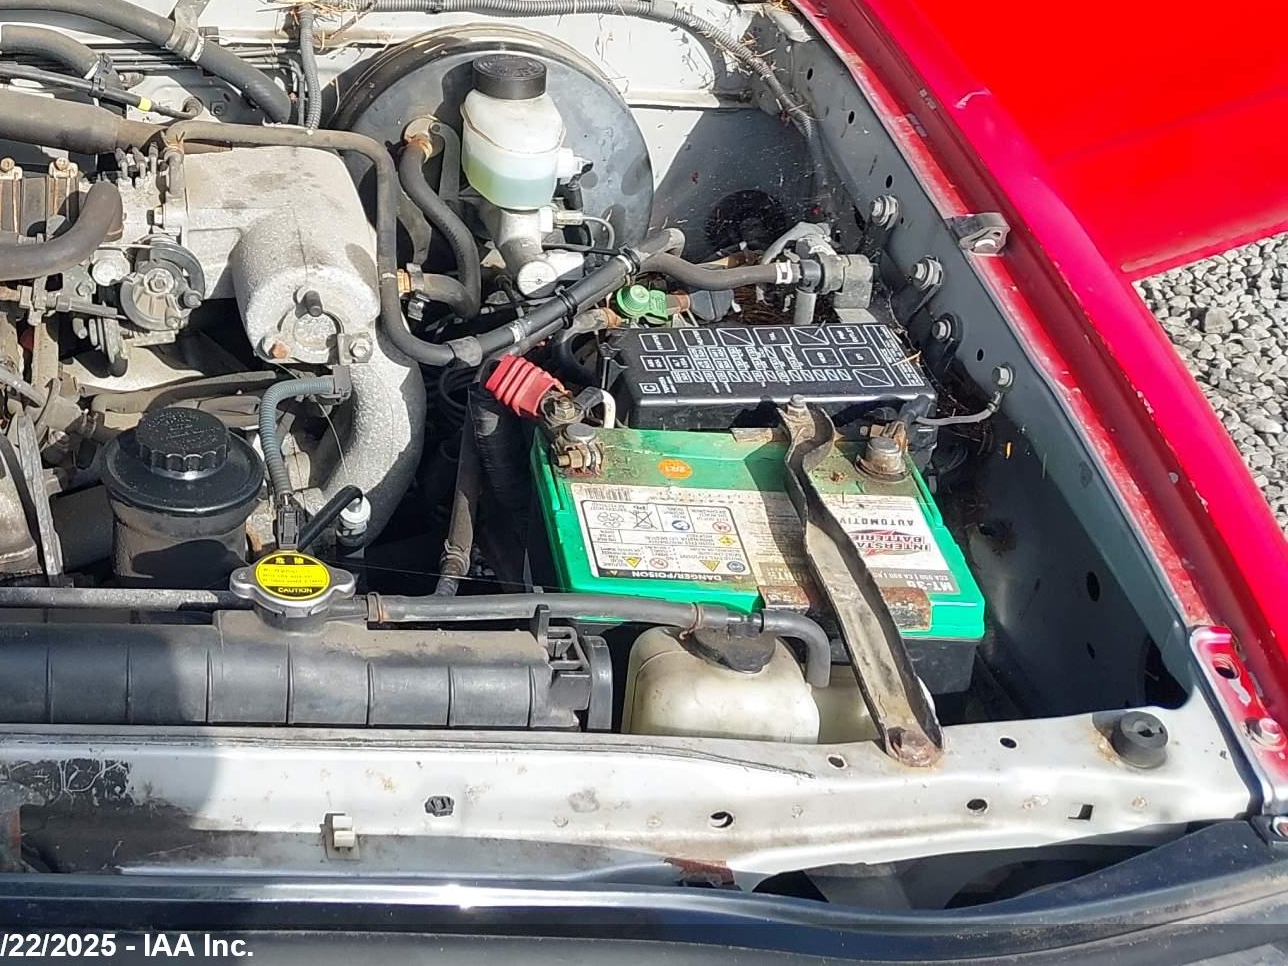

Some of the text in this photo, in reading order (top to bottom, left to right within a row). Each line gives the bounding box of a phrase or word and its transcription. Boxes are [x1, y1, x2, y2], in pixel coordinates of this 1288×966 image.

[839, 517, 915, 527] AUTOMOTIV
[851, 534, 925, 543] BATTERIE
[855, 540, 931, 551] INTERSTA
[631, 570, 722, 582] DANGER/POISON
